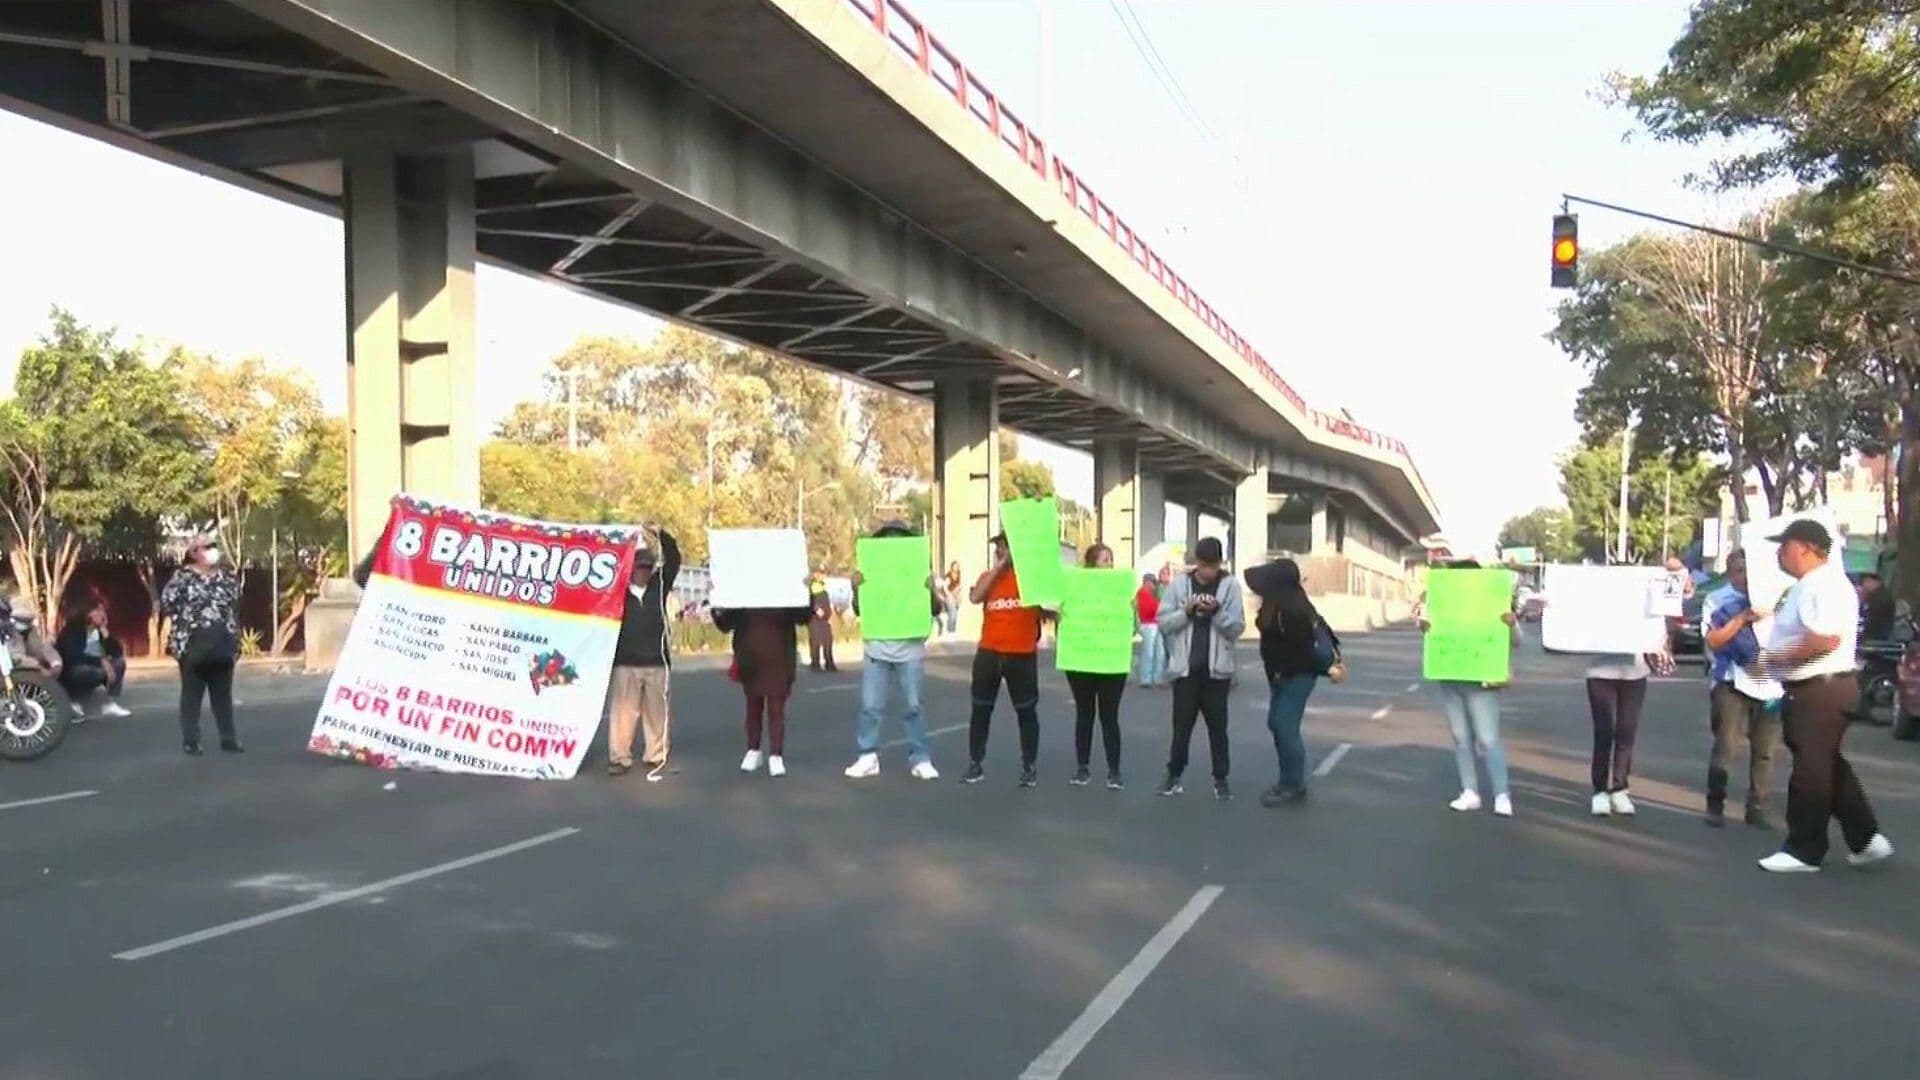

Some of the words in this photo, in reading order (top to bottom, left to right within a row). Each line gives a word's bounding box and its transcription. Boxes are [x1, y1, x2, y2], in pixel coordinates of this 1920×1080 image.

[395, 521, 424, 558] 8
[429, 526, 618, 590] BARRIOS
[446, 567, 555, 605] UNIDOS
[383, 613, 404, 627] SAN
[386, 602, 408, 616] SAN
[411, 611, 446, 625] PEDRO
[378, 625, 400, 639] SAN
[470, 623, 500, 636] SANTA
[502, 628, 549, 645] BARBARA
[463, 648, 482, 660] SAN
[466, 636, 486, 648] SAN
[488, 641, 521, 654] PABLO
[459, 661, 478, 673] SAN
[482, 666, 516, 681] MIGUEL
[335, 685, 390, 718] POR
[398, 705, 432, 733] UN
[439, 716, 481, 743] FIN
[396, 685, 411, 701] 8
[416, 689, 513, 725] BARRIOS
[322, 715, 357, 733] PARA
[360, 725, 433, 755] BIENESTAR
[434, 747, 452, 761] DE
[453, 753, 518, 773] NUESTRAS
